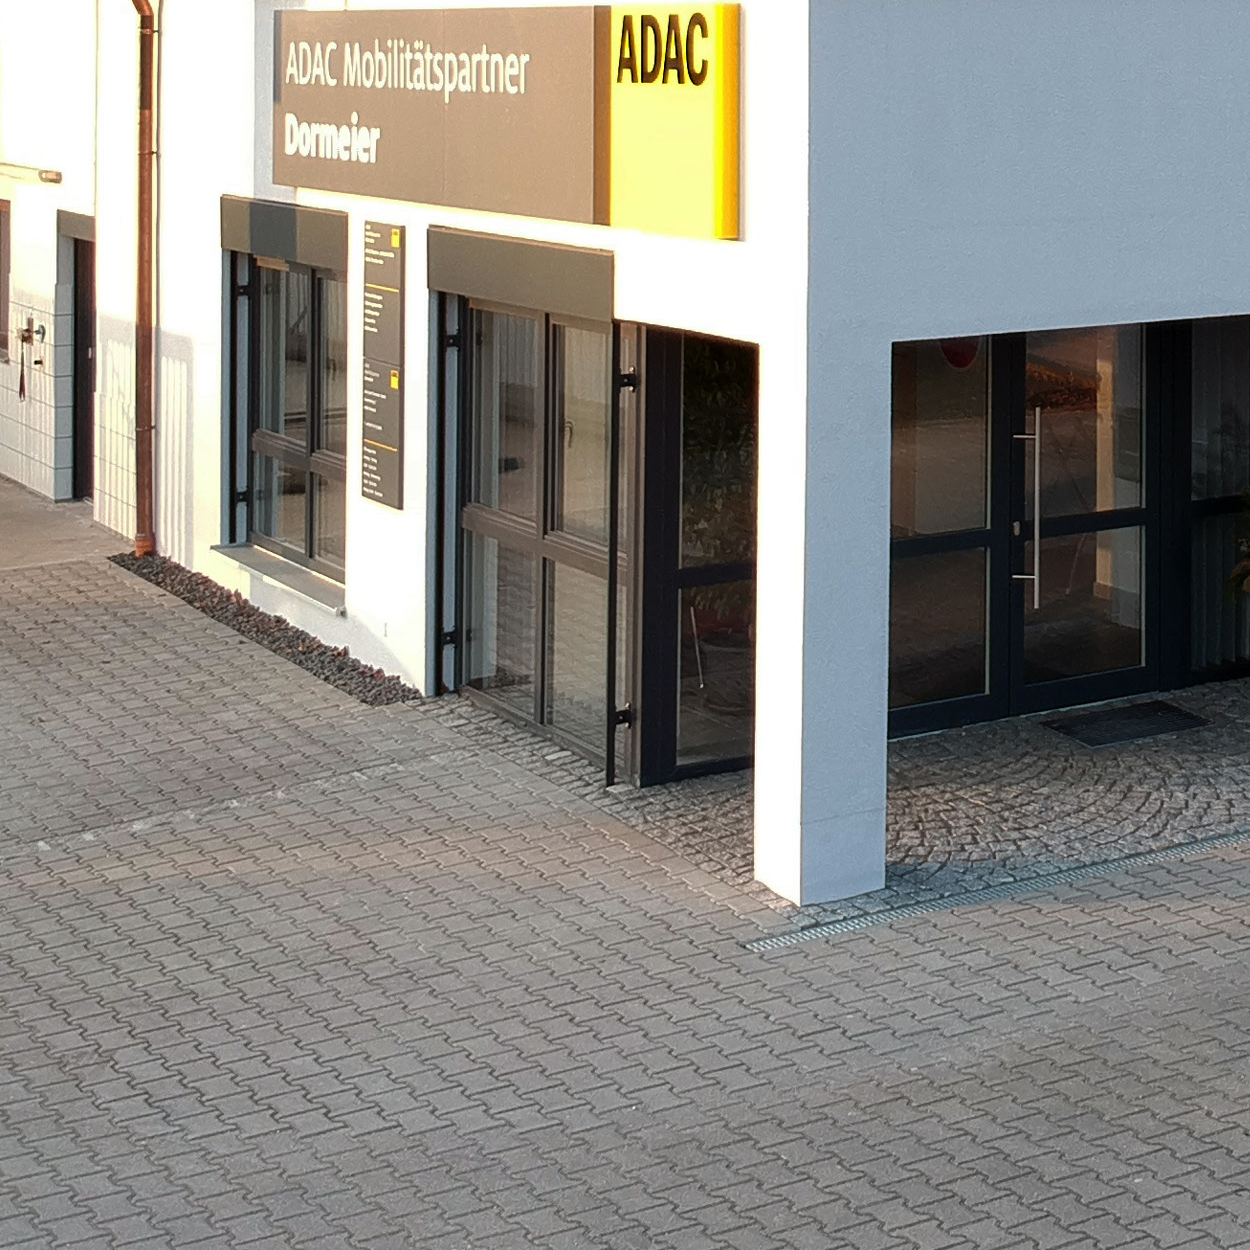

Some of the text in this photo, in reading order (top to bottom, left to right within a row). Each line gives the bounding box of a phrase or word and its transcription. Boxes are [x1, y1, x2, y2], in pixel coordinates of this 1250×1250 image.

[285, 38, 531, 103] ADAC Mobilitätspartner
[617, 11, 710, 87] ADAC
[284, 111, 381, 164] Dormeier
